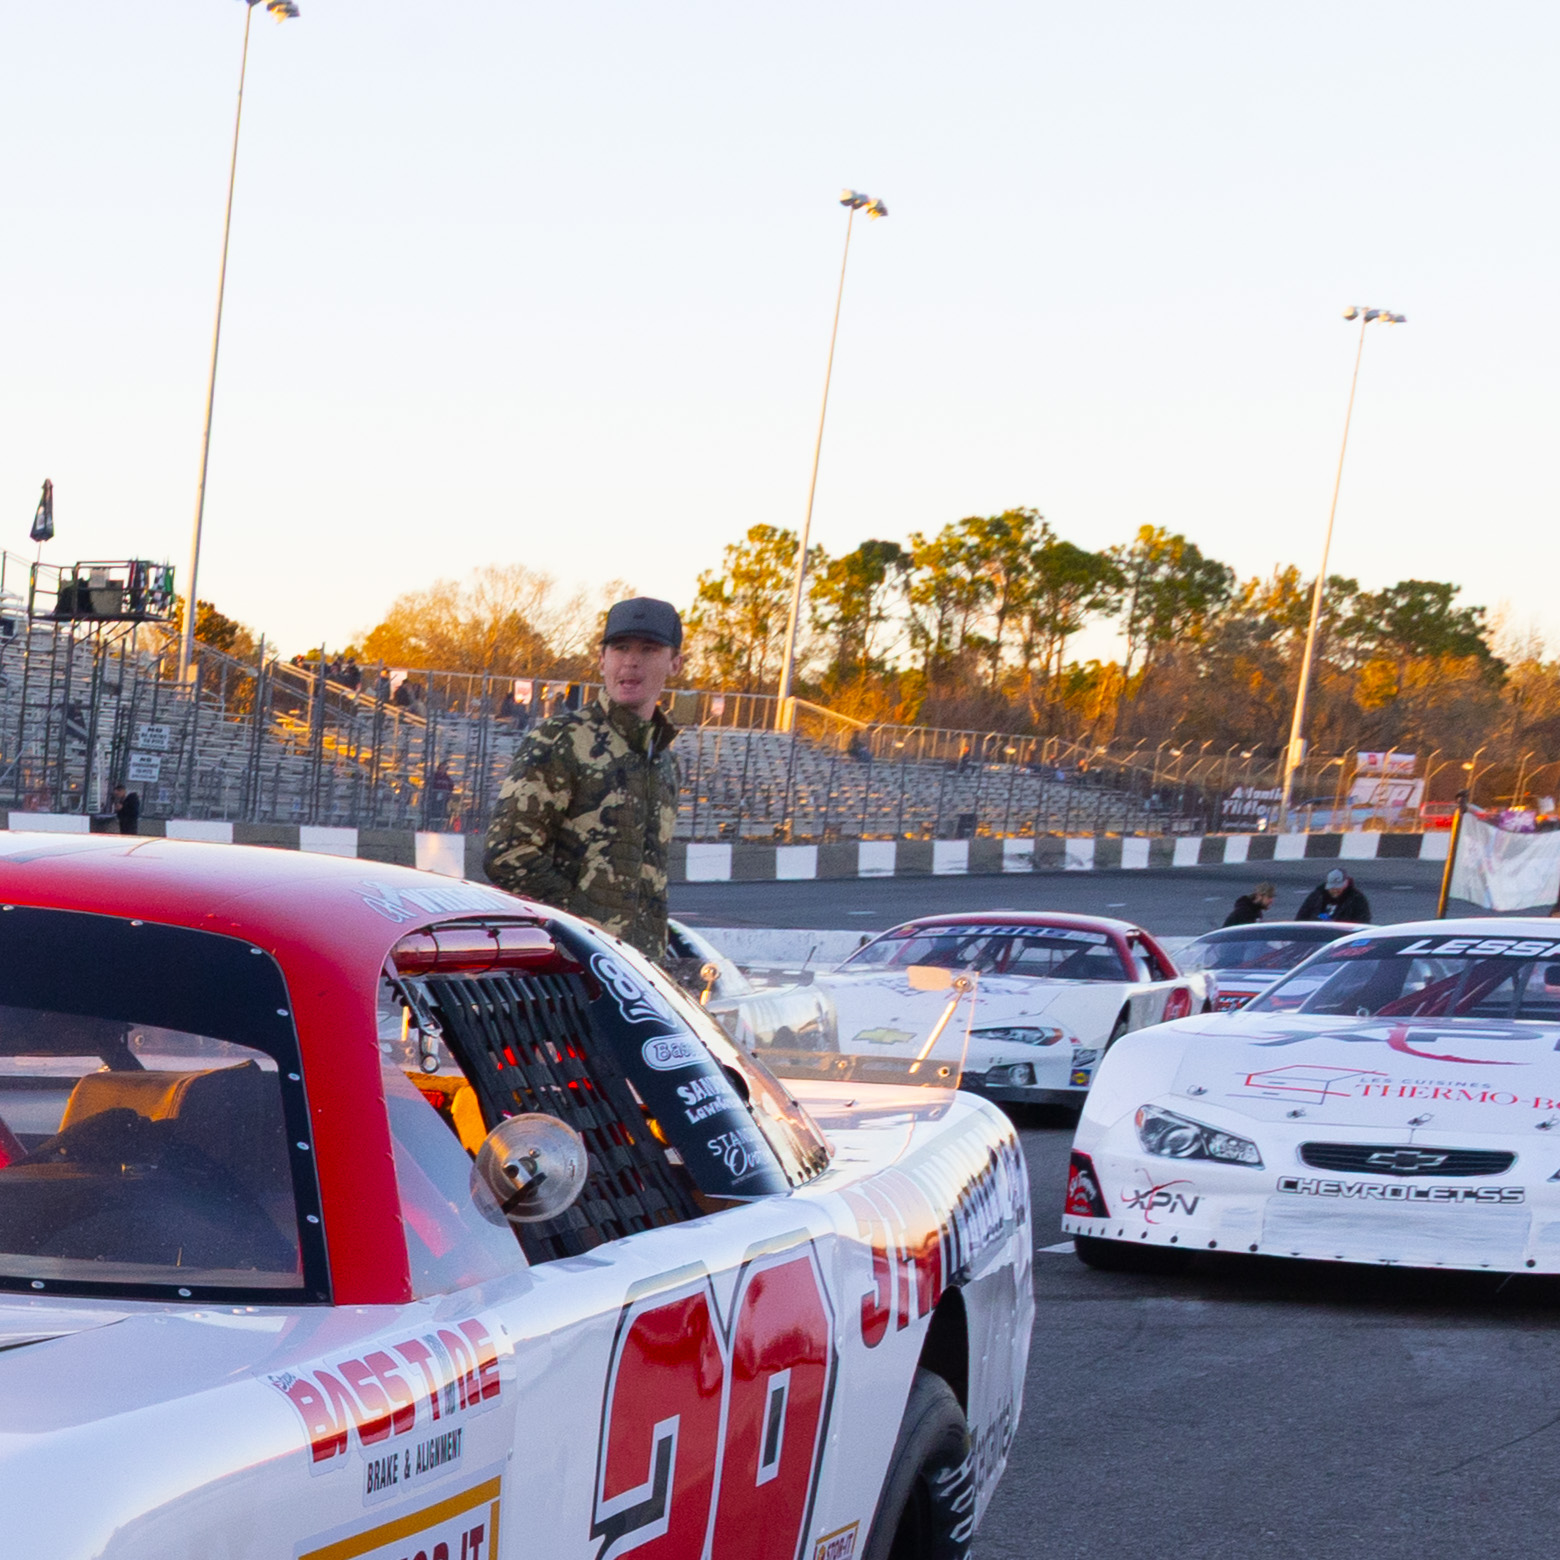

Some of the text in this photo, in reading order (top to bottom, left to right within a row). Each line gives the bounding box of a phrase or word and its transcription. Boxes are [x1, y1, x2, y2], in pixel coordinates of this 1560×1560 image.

[287, 1350, 416, 1463] BASS
[366, 1427, 463, 1494] BRAKE & ALIGNMENT
